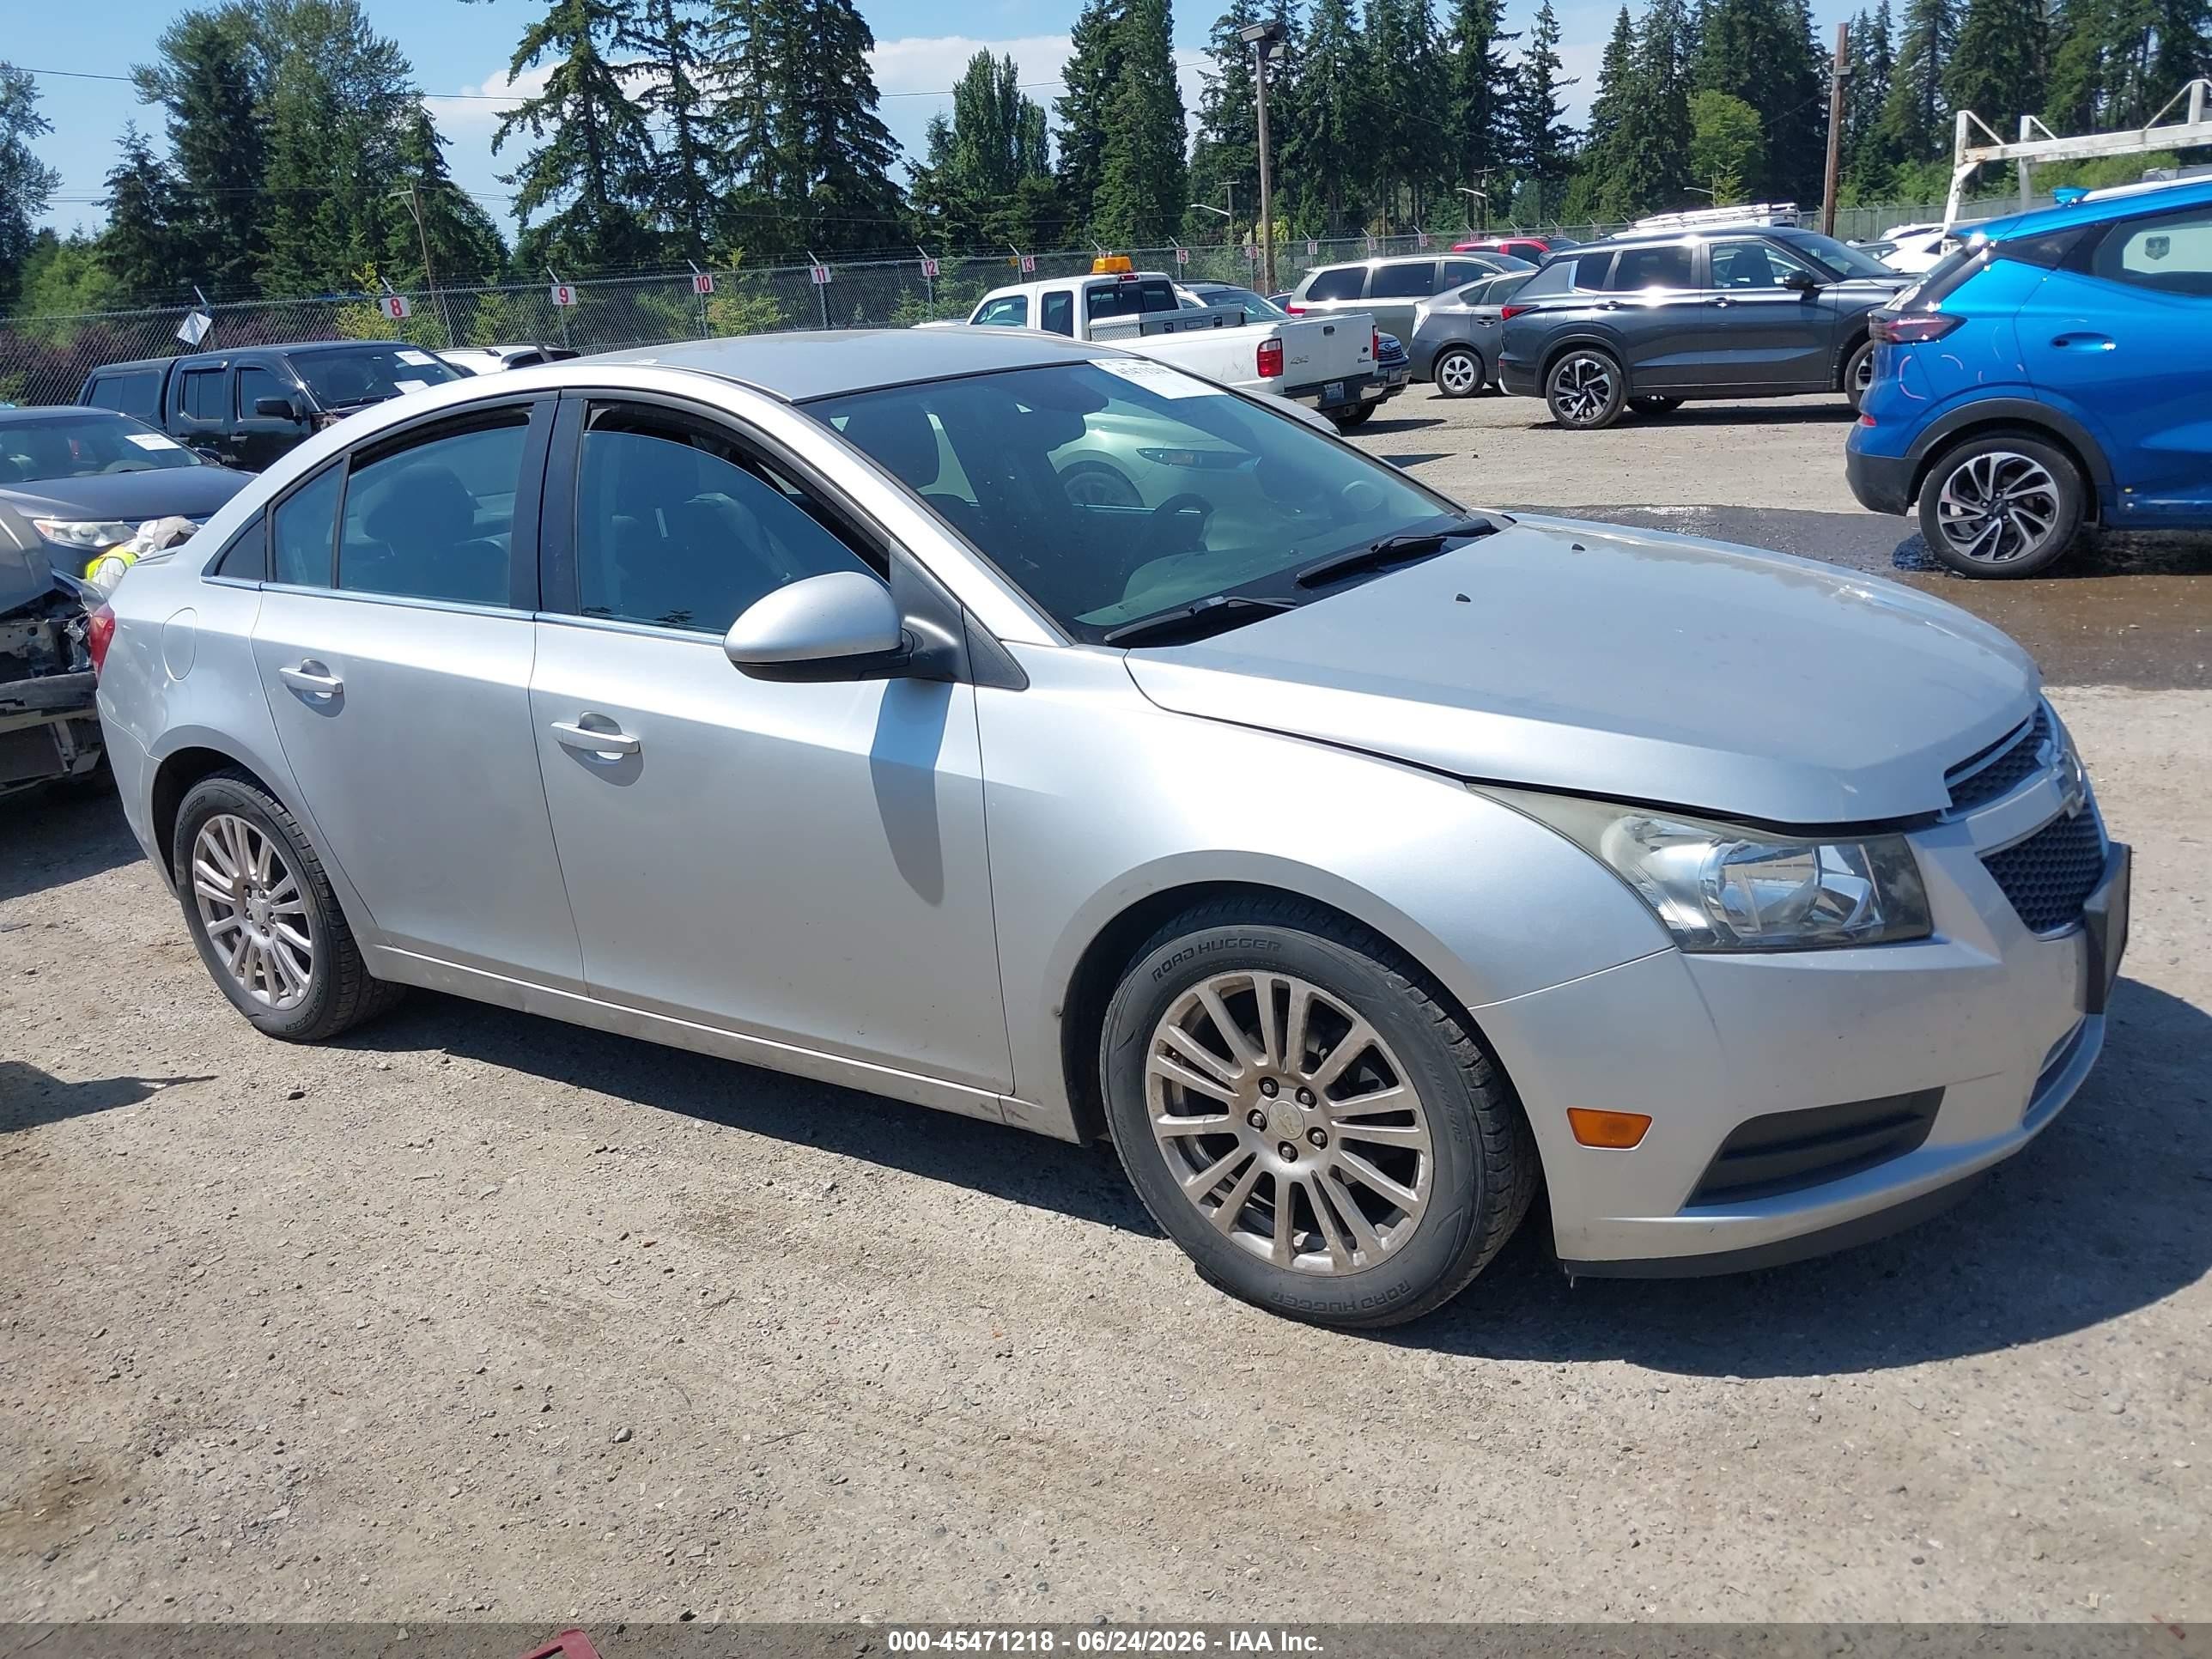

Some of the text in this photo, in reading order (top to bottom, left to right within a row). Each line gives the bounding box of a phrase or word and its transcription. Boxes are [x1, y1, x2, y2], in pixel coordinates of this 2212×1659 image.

[1249, 246, 1258, 259] 16
[1309, 242, 1317, 254] 17
[1023, 256, 1034, 271] 13
[1178, 250, 1188, 263] 15
[814, 268, 826, 283] 11
[924, 260, 937, 276] 12
[696, 275, 711, 293] 10
[558, 287, 569, 304] 9
[390, 298, 403, 318] 8
[1151, 938, 1283, 983] ROAD HUGGER
[1271, 1279, 1412, 1312] ROAD HUGGER
